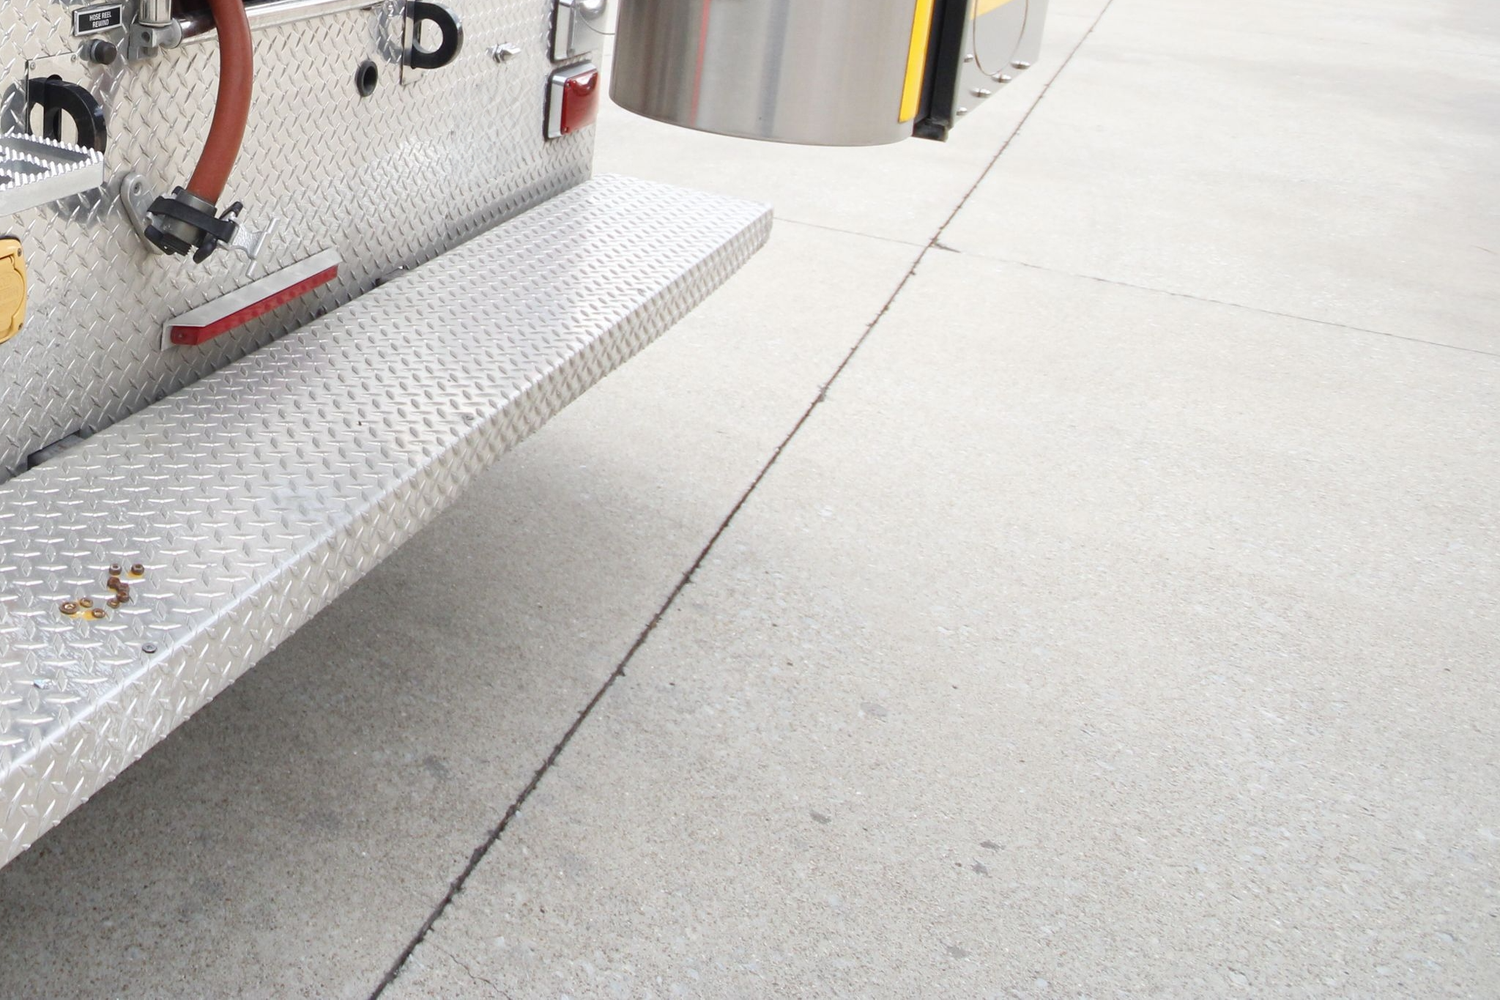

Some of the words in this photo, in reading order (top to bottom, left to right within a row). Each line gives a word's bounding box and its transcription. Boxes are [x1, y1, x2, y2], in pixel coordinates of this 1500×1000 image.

[89, 12, 101, 22] HOSE
[102, 11, 112, 20] REEL
[92, 19, 109, 28] REWIND
